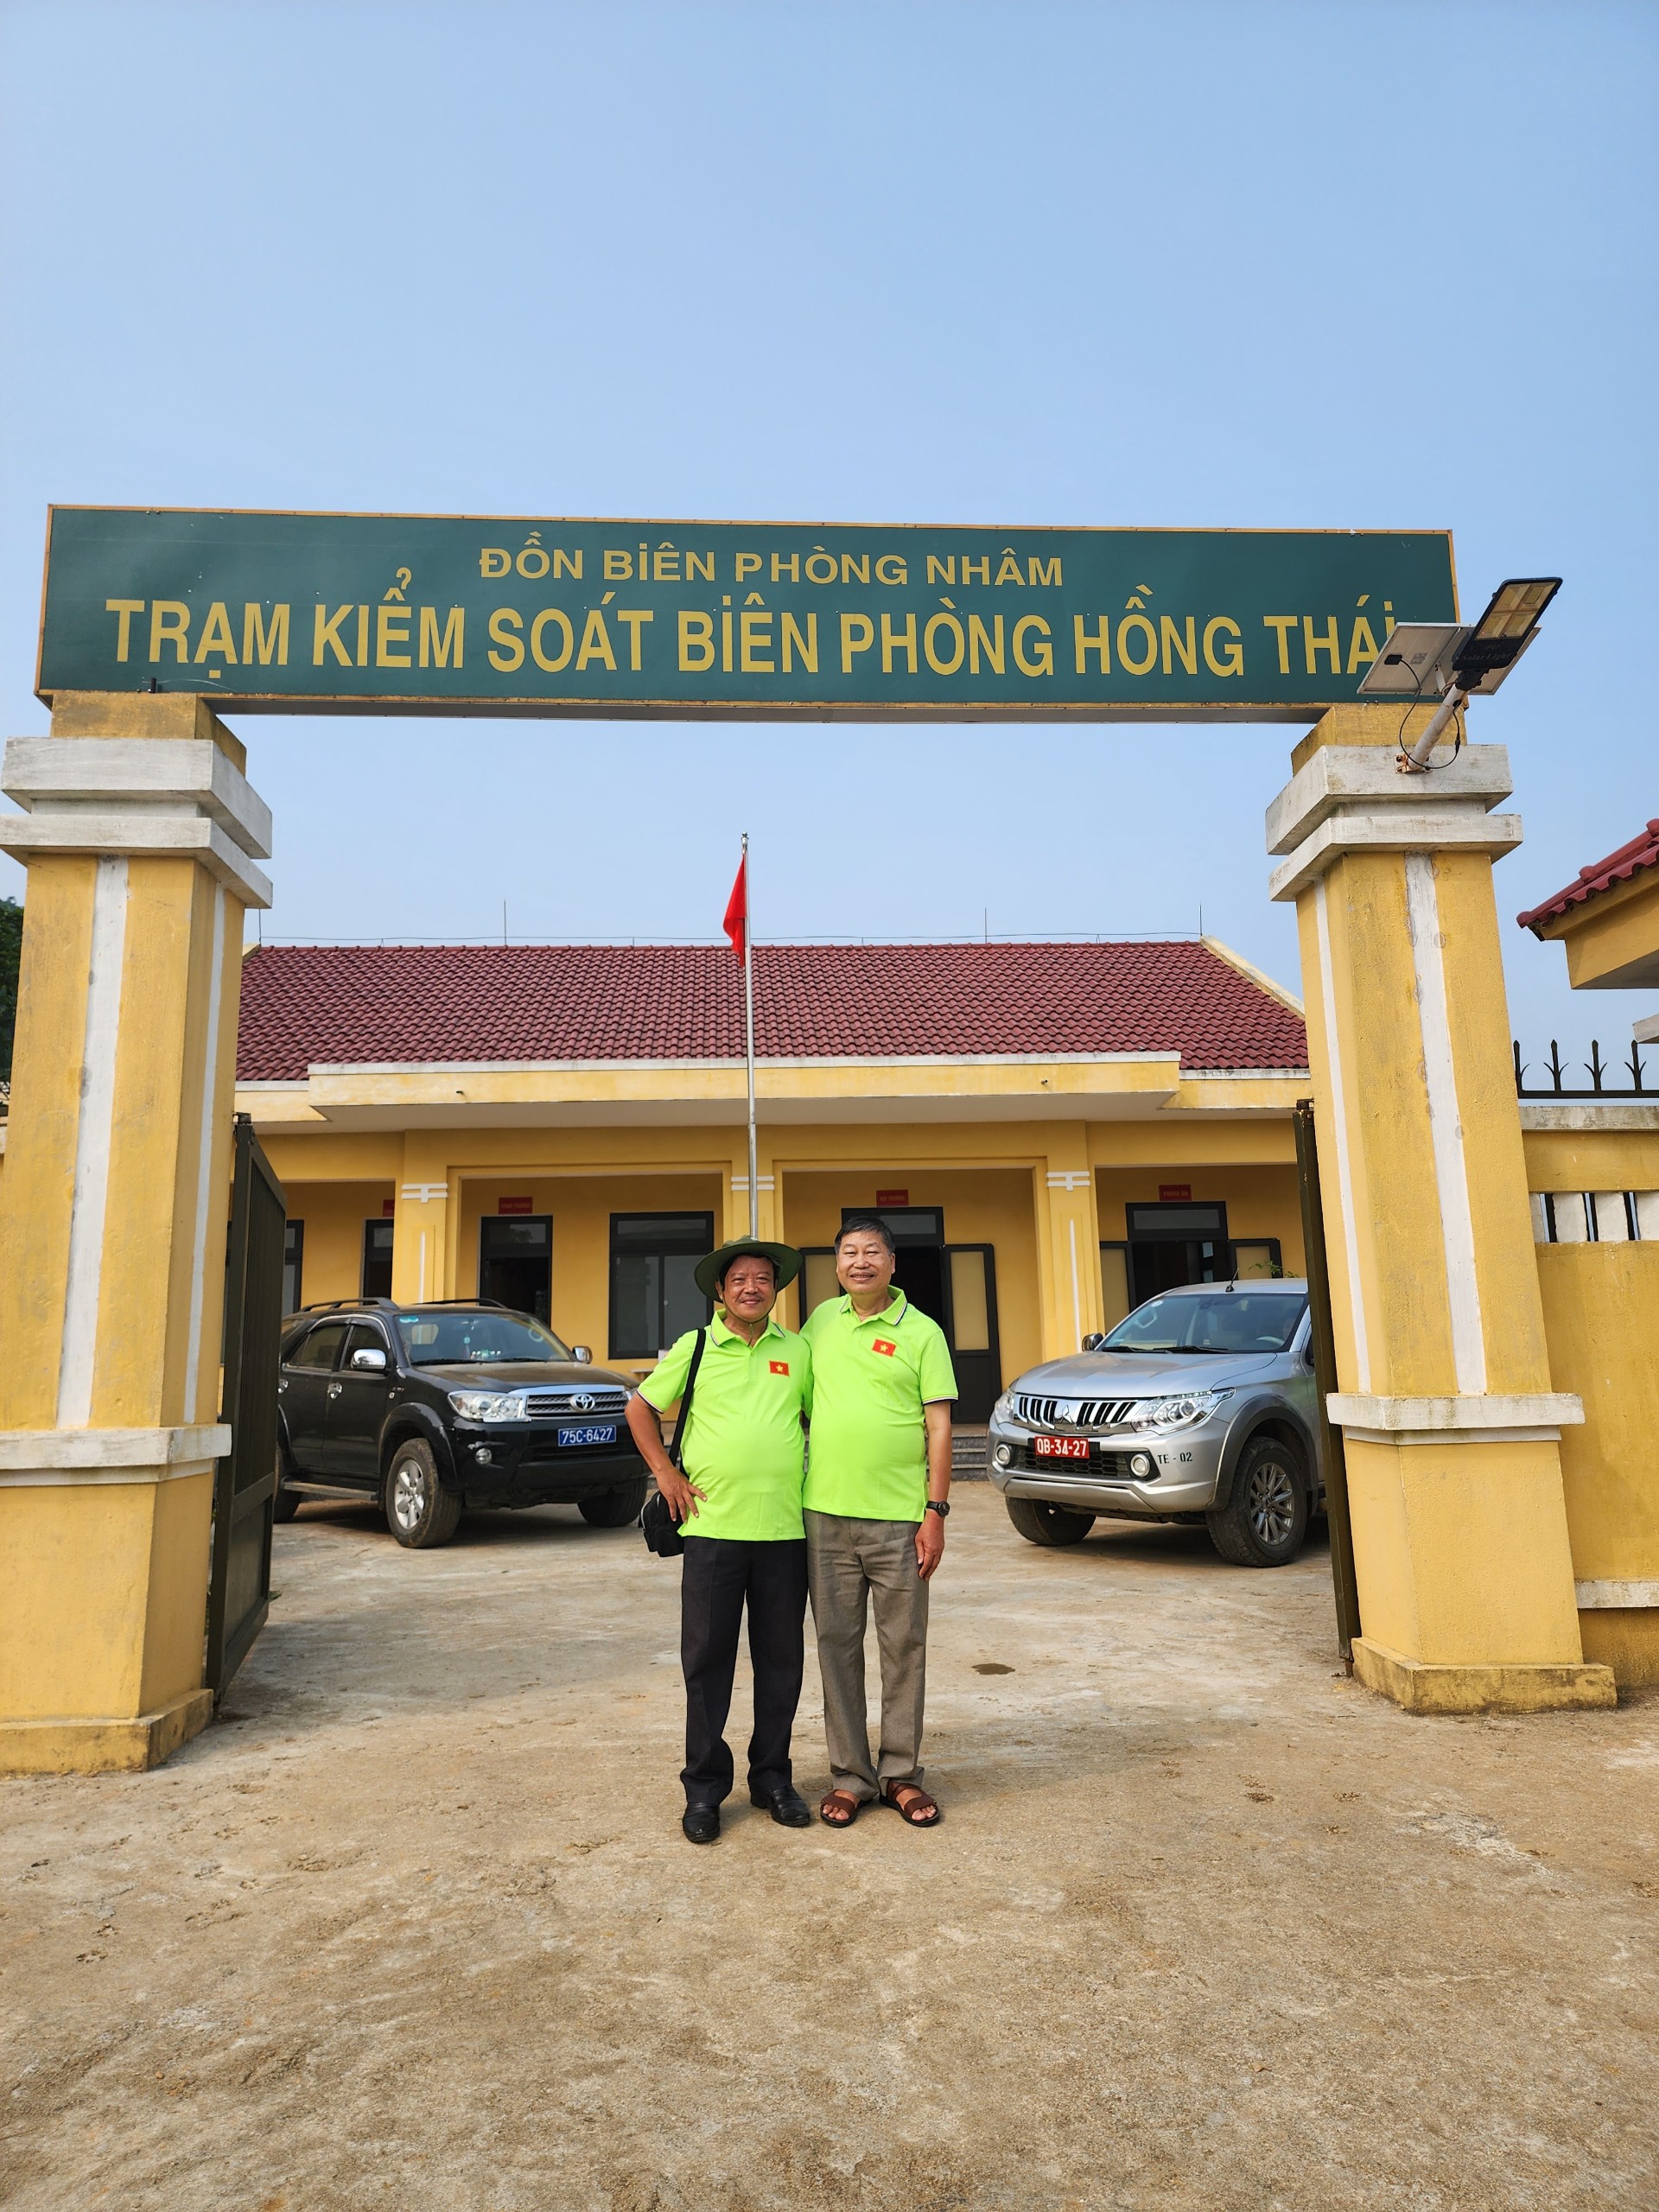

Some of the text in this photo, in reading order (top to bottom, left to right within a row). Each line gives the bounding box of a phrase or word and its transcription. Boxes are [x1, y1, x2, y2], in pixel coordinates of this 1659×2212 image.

[479, 531, 583, 580] ĐỒN
[736, 544, 907, 588] PHÒNG
[926, 547, 1063, 587] NHÂM
[105, 599, 290, 680] TRẠM
[313, 567, 467, 671] KIỂM
[487, 591, 654, 672] SOÁT
[840, 596, 1054, 677] PHÒNG
[1073, 584, 1244, 677] HỒNG
[562, 1427, 613, 1444] 75C-6427
[1037, 1438, 1087, 1457] QB-34-27
[1157, 1454, 1170, 1464] TE
[1179, 1452, 1193, 1462] 02
